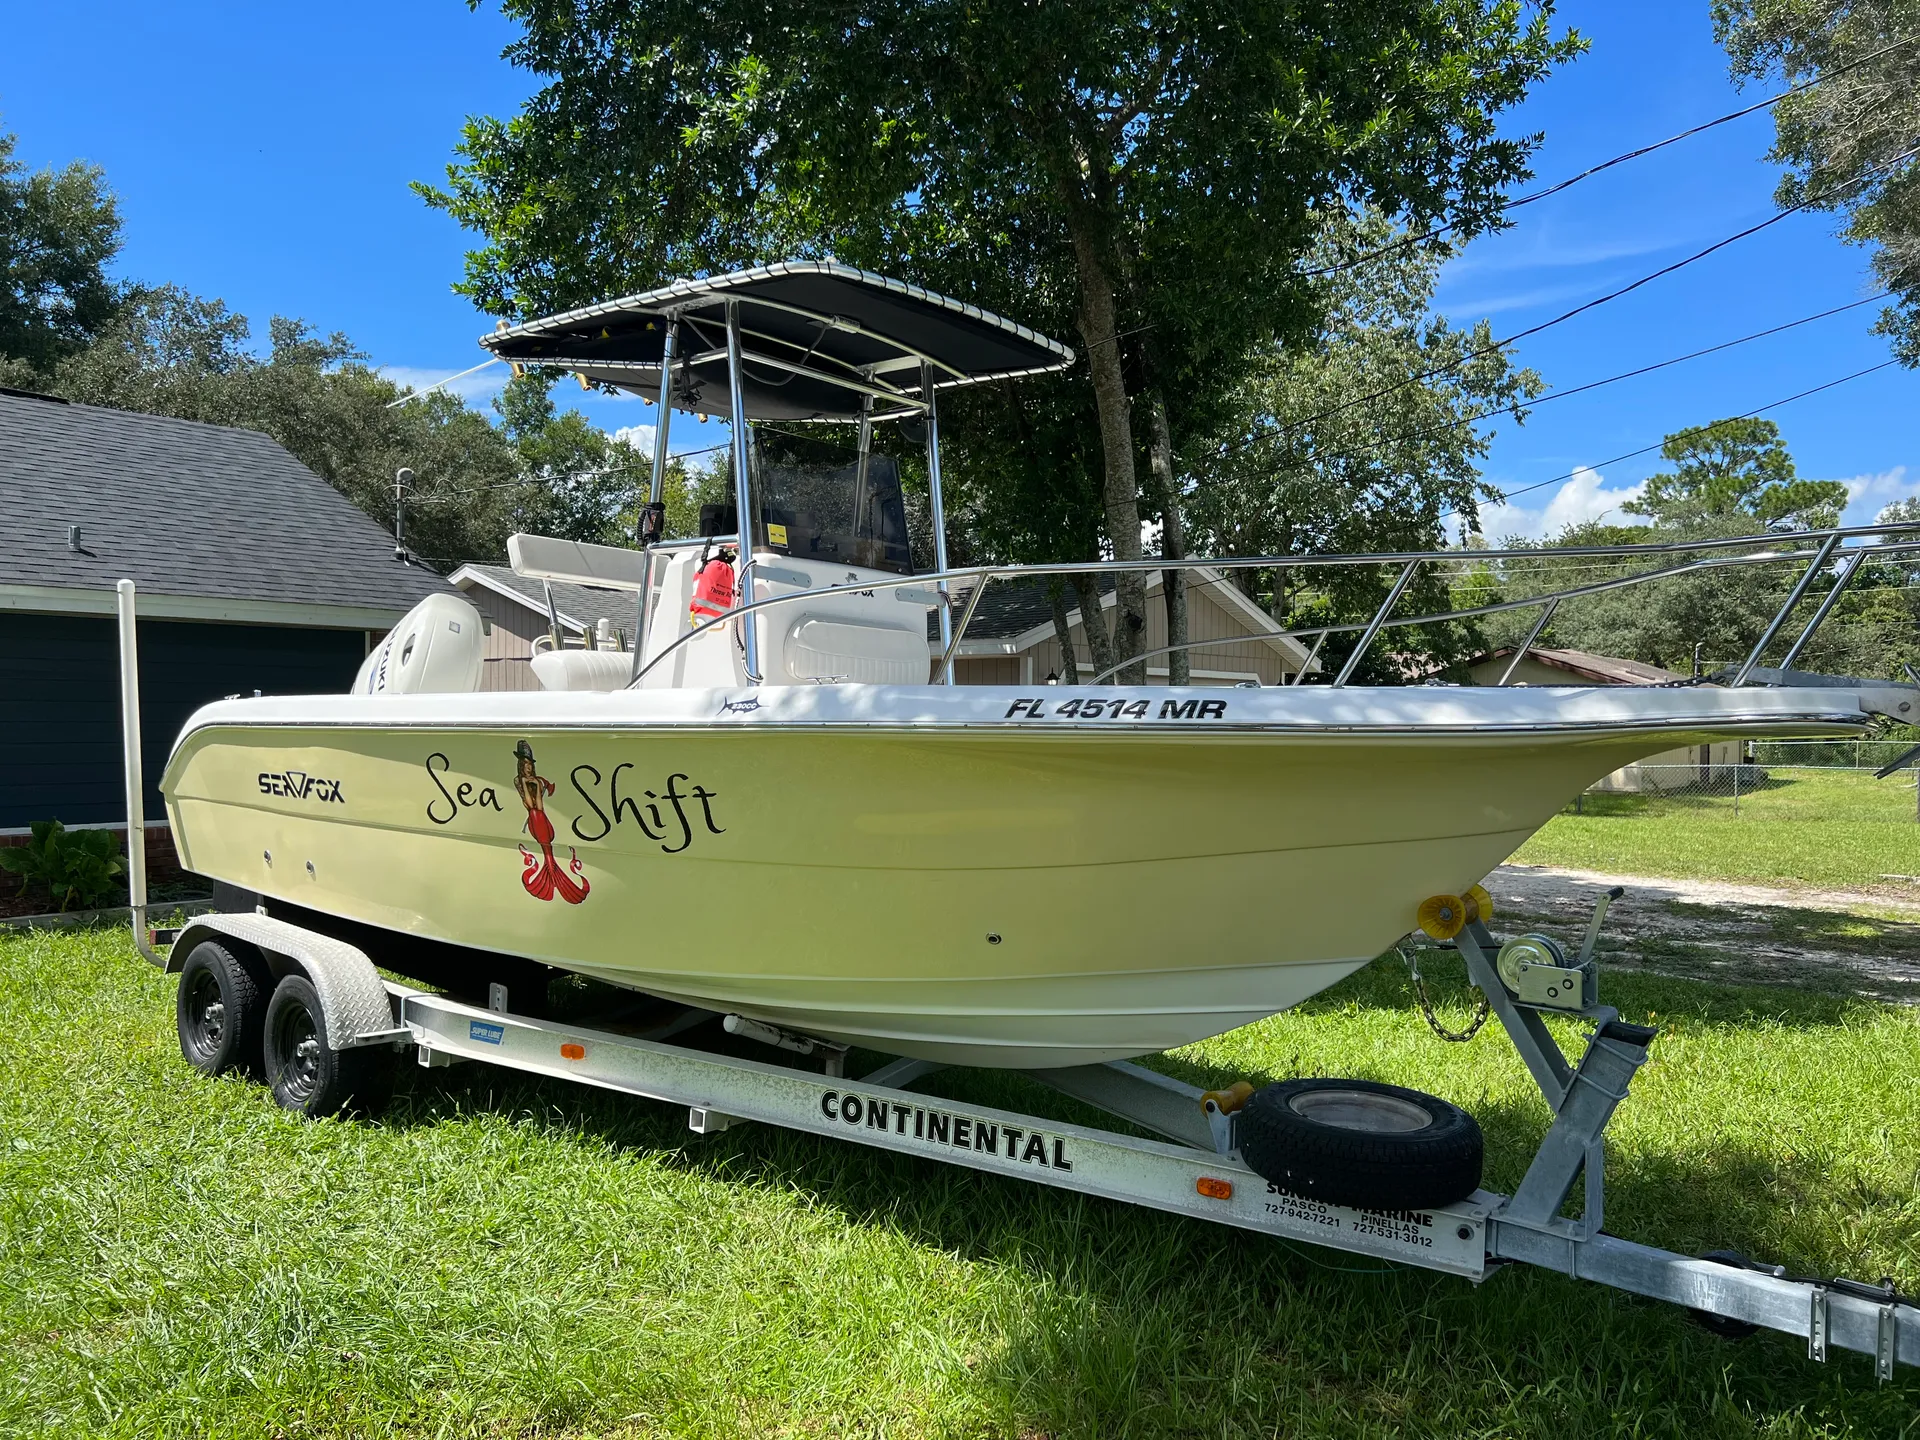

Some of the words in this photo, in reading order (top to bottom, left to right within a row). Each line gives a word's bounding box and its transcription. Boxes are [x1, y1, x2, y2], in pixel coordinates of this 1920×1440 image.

[1004, 698, 1045, 719] FL
[1055, 698, 1152, 719] 4514
[1157, 699, 1228, 720] MR
[425, 752, 504, 825] Sea
[570, 763, 727, 853] Shift
[471, 1026, 487, 1036] SUPER
[820, 1088, 1074, 1173] CONTINENTAL
[1265, 1203, 1340, 1227] 727-942-7221
[1282, 1198, 1327, 1214] PASCO
[1353, 1222, 1433, 1248] 727-531-3012
[1361, 1214, 1419, 1235] PINELLAS
